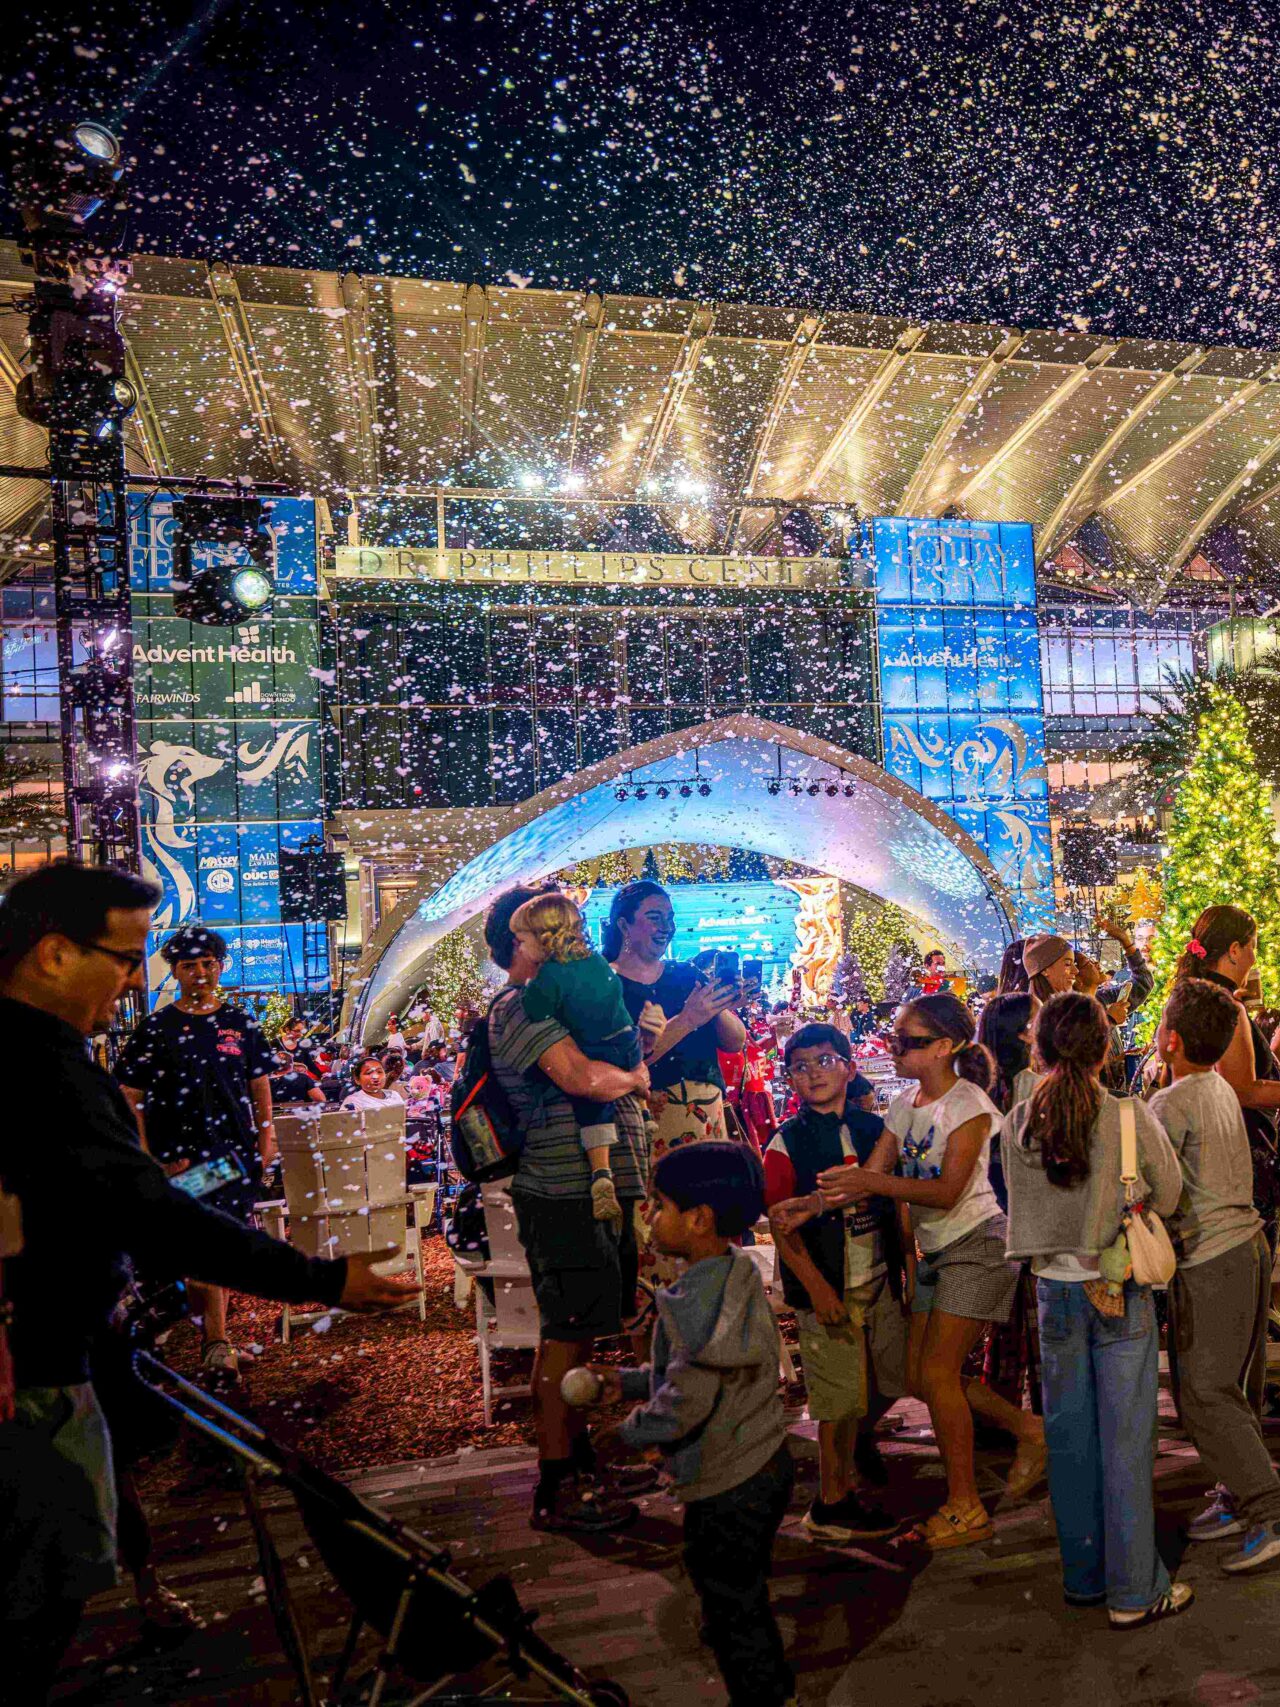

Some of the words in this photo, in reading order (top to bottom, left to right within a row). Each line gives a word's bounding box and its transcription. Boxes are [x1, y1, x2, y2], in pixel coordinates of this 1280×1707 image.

[459, 552, 664, 581] PHILLIPS
[688, 557, 794, 585] CENT
[132, 644, 296, 663] AdventHealth
[136, 693, 201, 704] FAIRWINDS
[199, 855, 238, 868] MASSEY
[249, 852, 278, 861] MAIN
[243, 871, 268, 880] OUC
